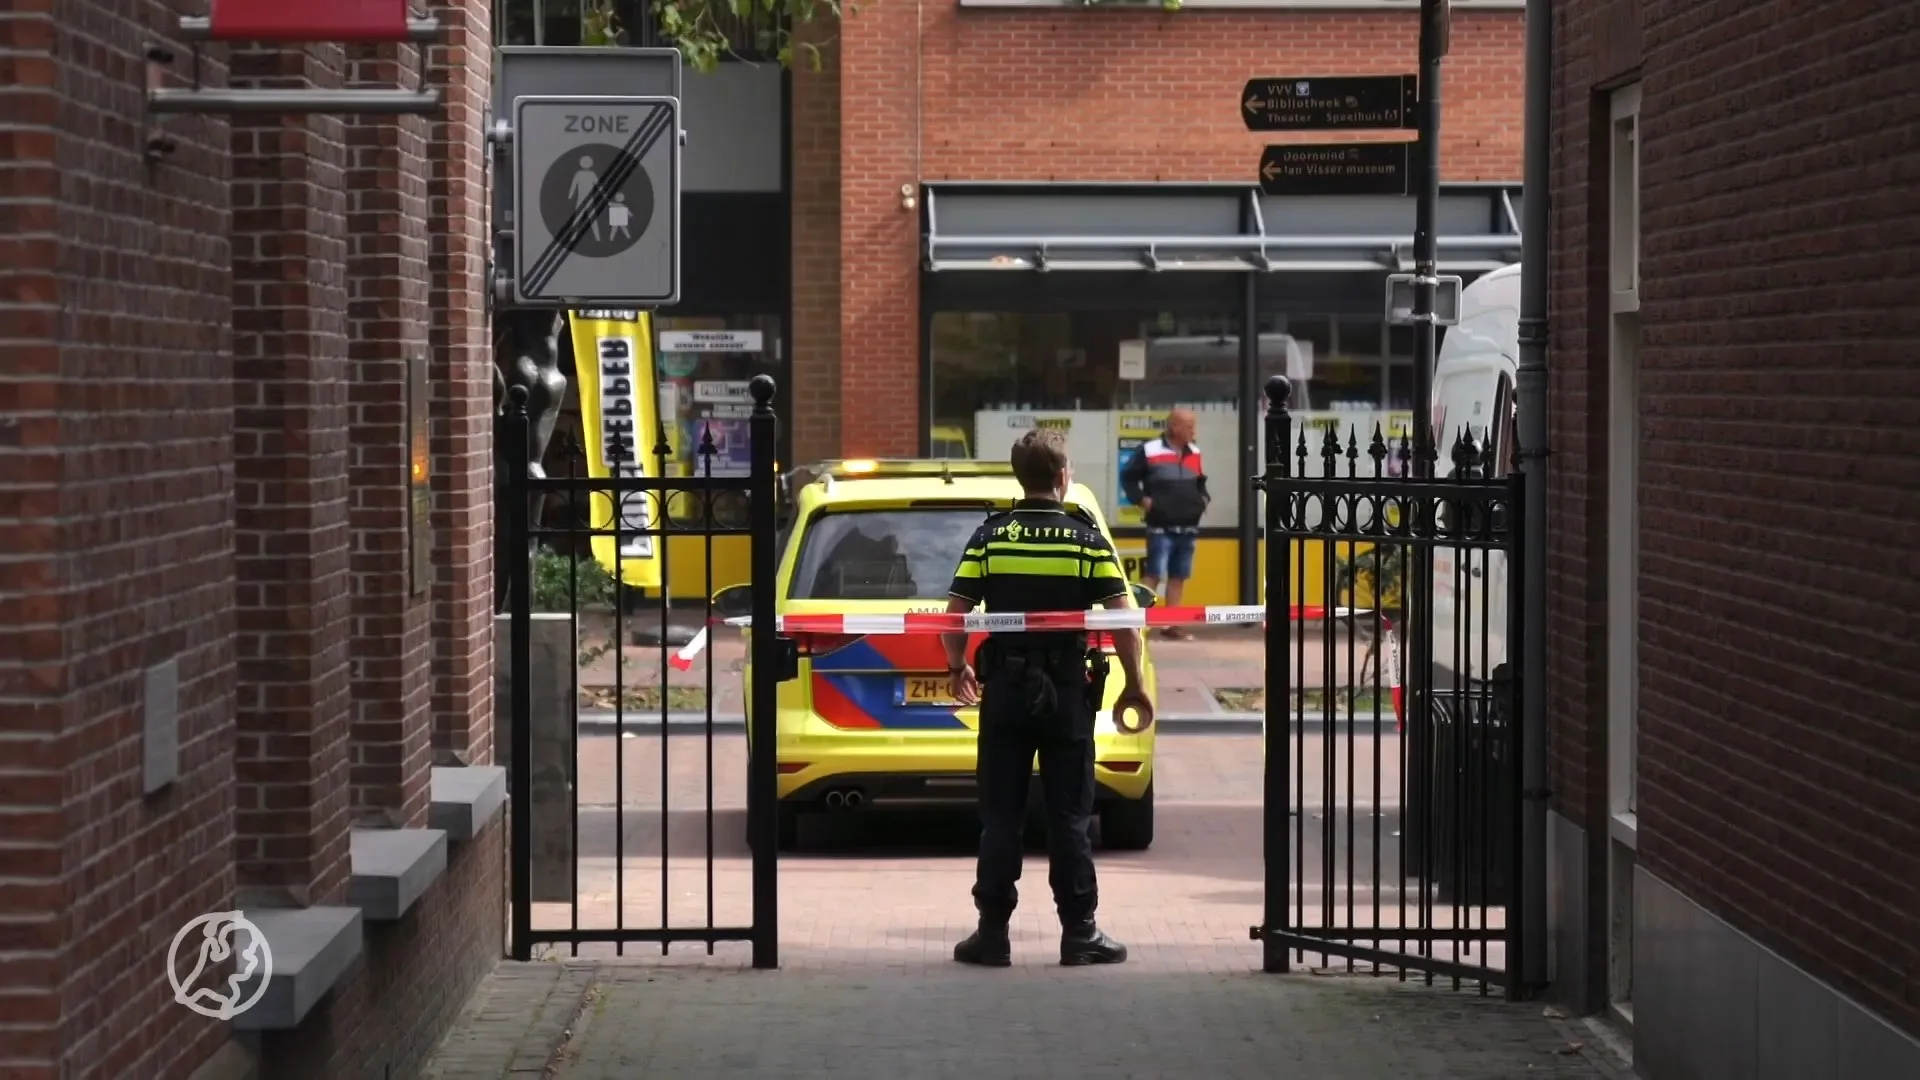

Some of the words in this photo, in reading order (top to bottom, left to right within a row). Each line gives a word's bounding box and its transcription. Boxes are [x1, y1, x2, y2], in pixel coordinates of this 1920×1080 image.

[1267, 83, 1293, 96] VVV
[1267, 97, 1341, 110] Bibliotheek
[564, 114, 630, 133] ZONE
[1267, 112, 1312, 123] Theater
[1326, 111, 1383, 124] Speelhuis
[1306, 164, 1343, 176] Visser
[1346, 163, 1396, 174] museum
